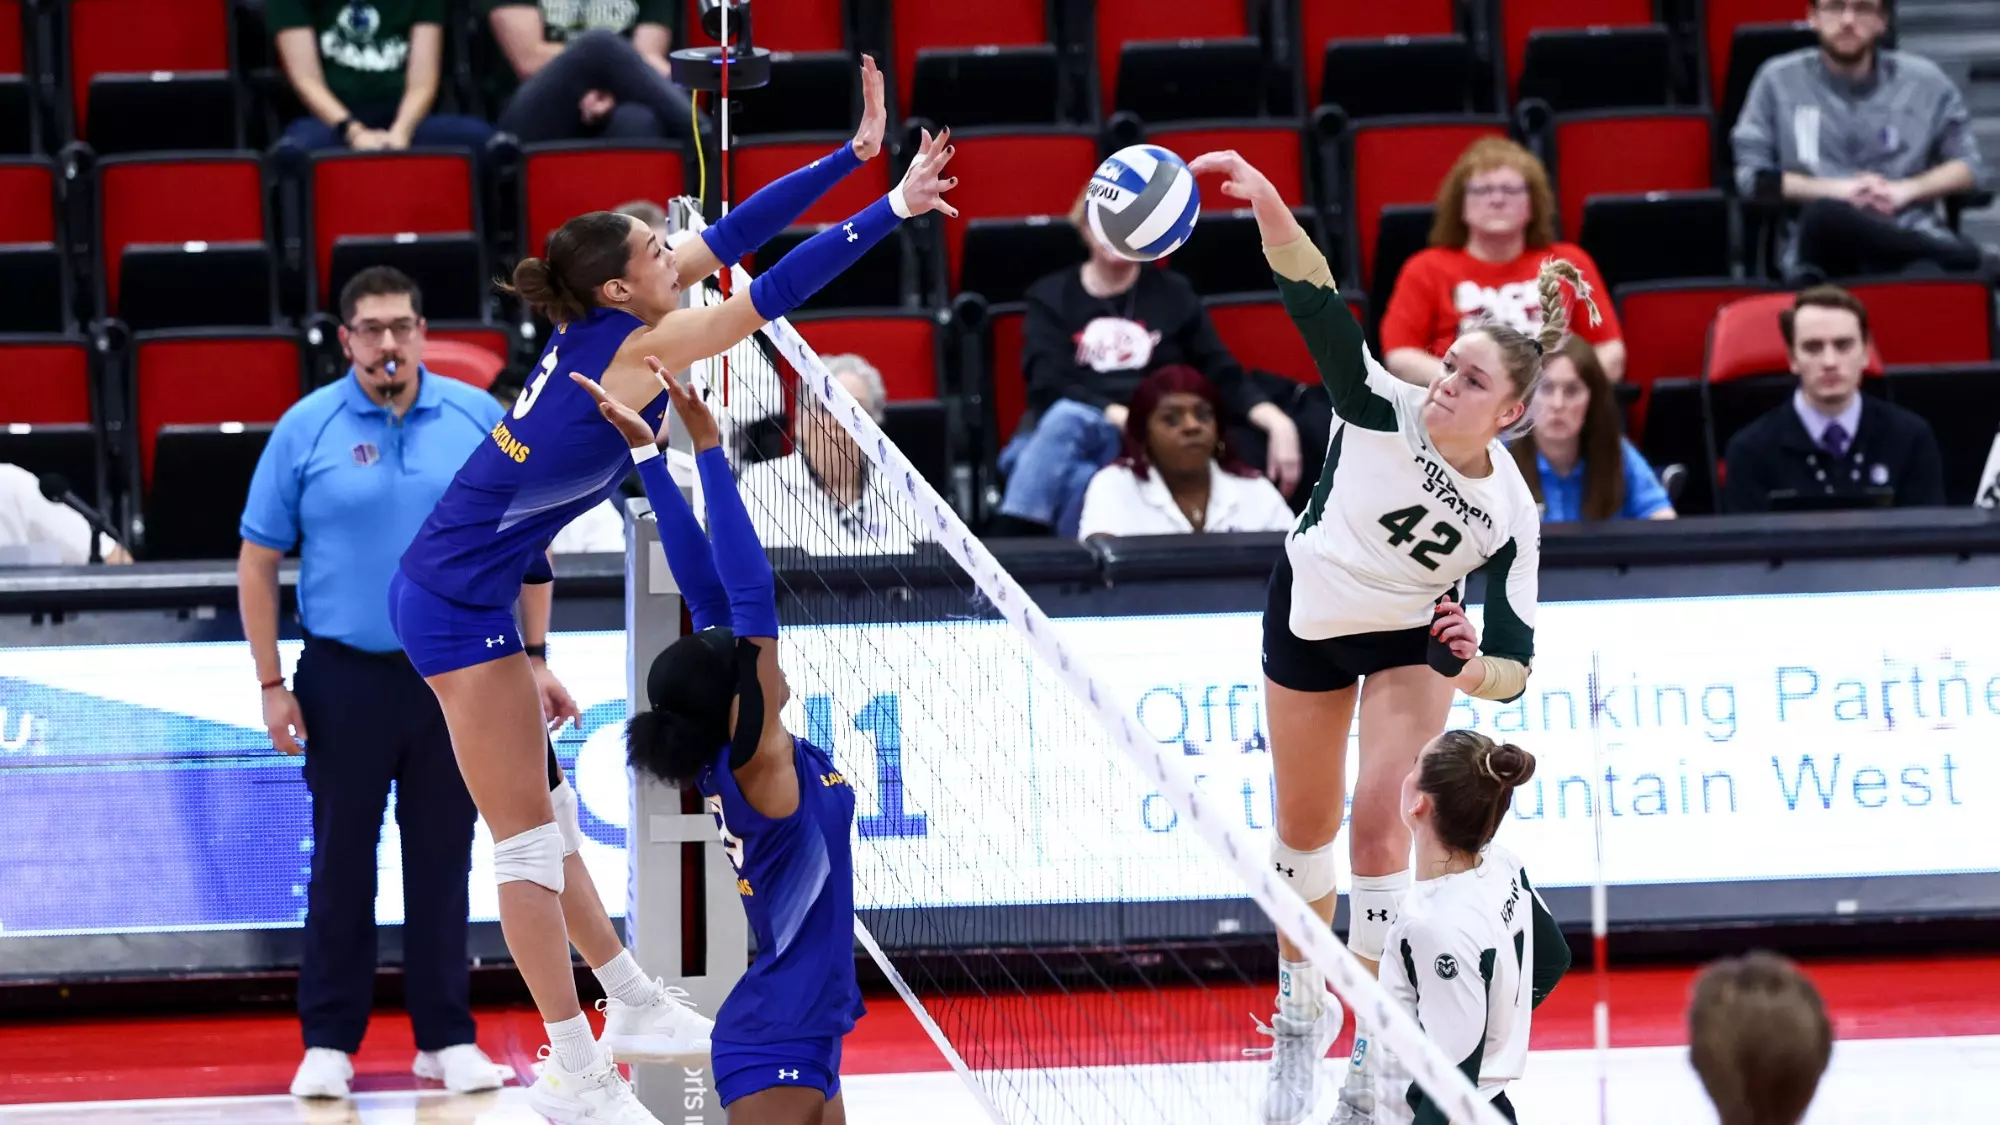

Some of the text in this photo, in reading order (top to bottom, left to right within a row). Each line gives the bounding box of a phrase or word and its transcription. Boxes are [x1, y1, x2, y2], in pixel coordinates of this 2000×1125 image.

[1377, 504, 1462, 571] 42
[1510, 758, 1738, 820] untain
[1770, 752, 1962, 811] West
